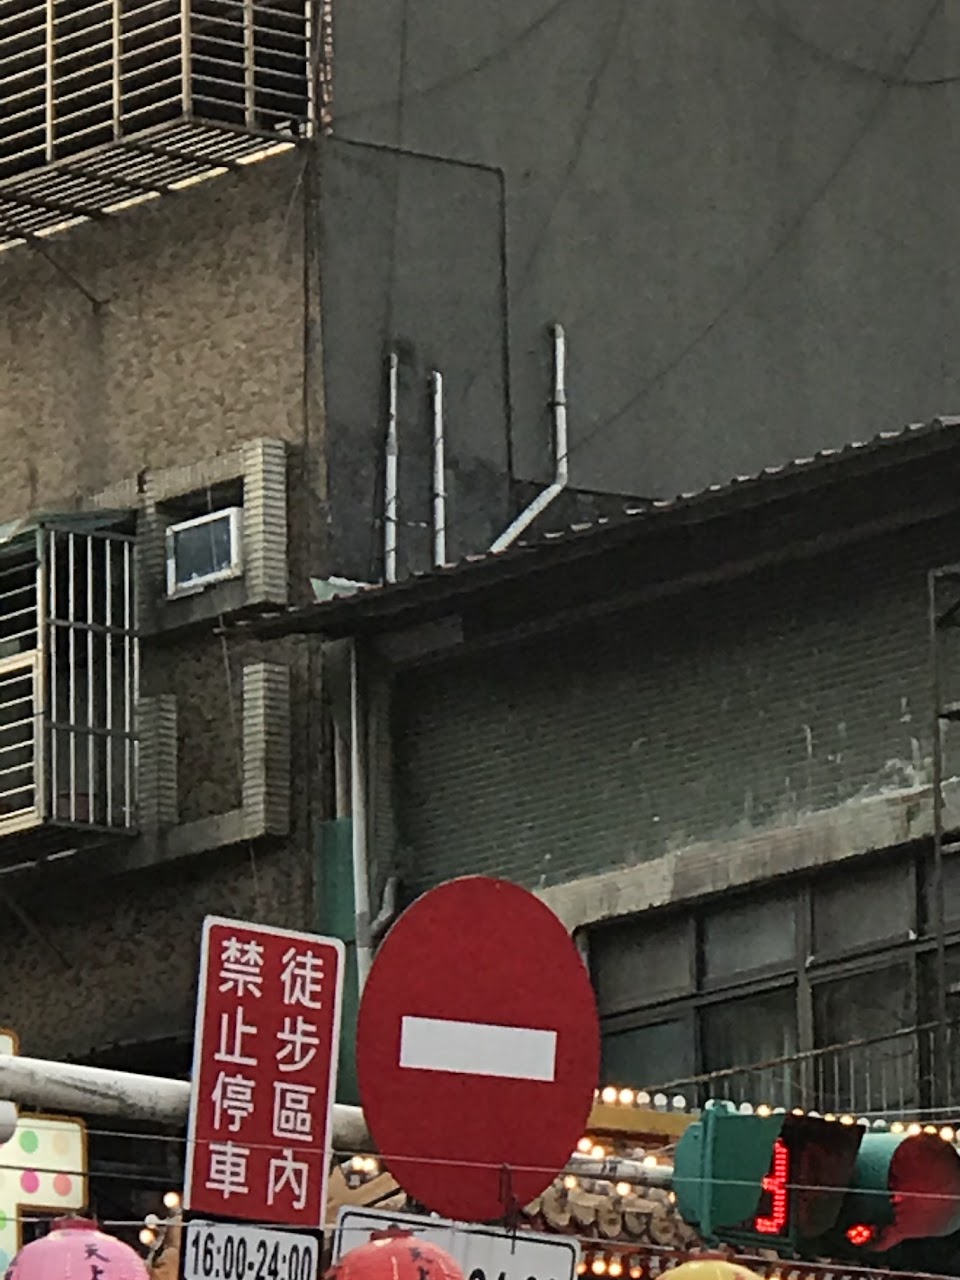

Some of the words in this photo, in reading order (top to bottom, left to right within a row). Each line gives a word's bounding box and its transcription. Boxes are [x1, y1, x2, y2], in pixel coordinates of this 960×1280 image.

[205, 936, 264, 1199] 禁止停車
[267, 947, 325, 1210] 徒步區內
